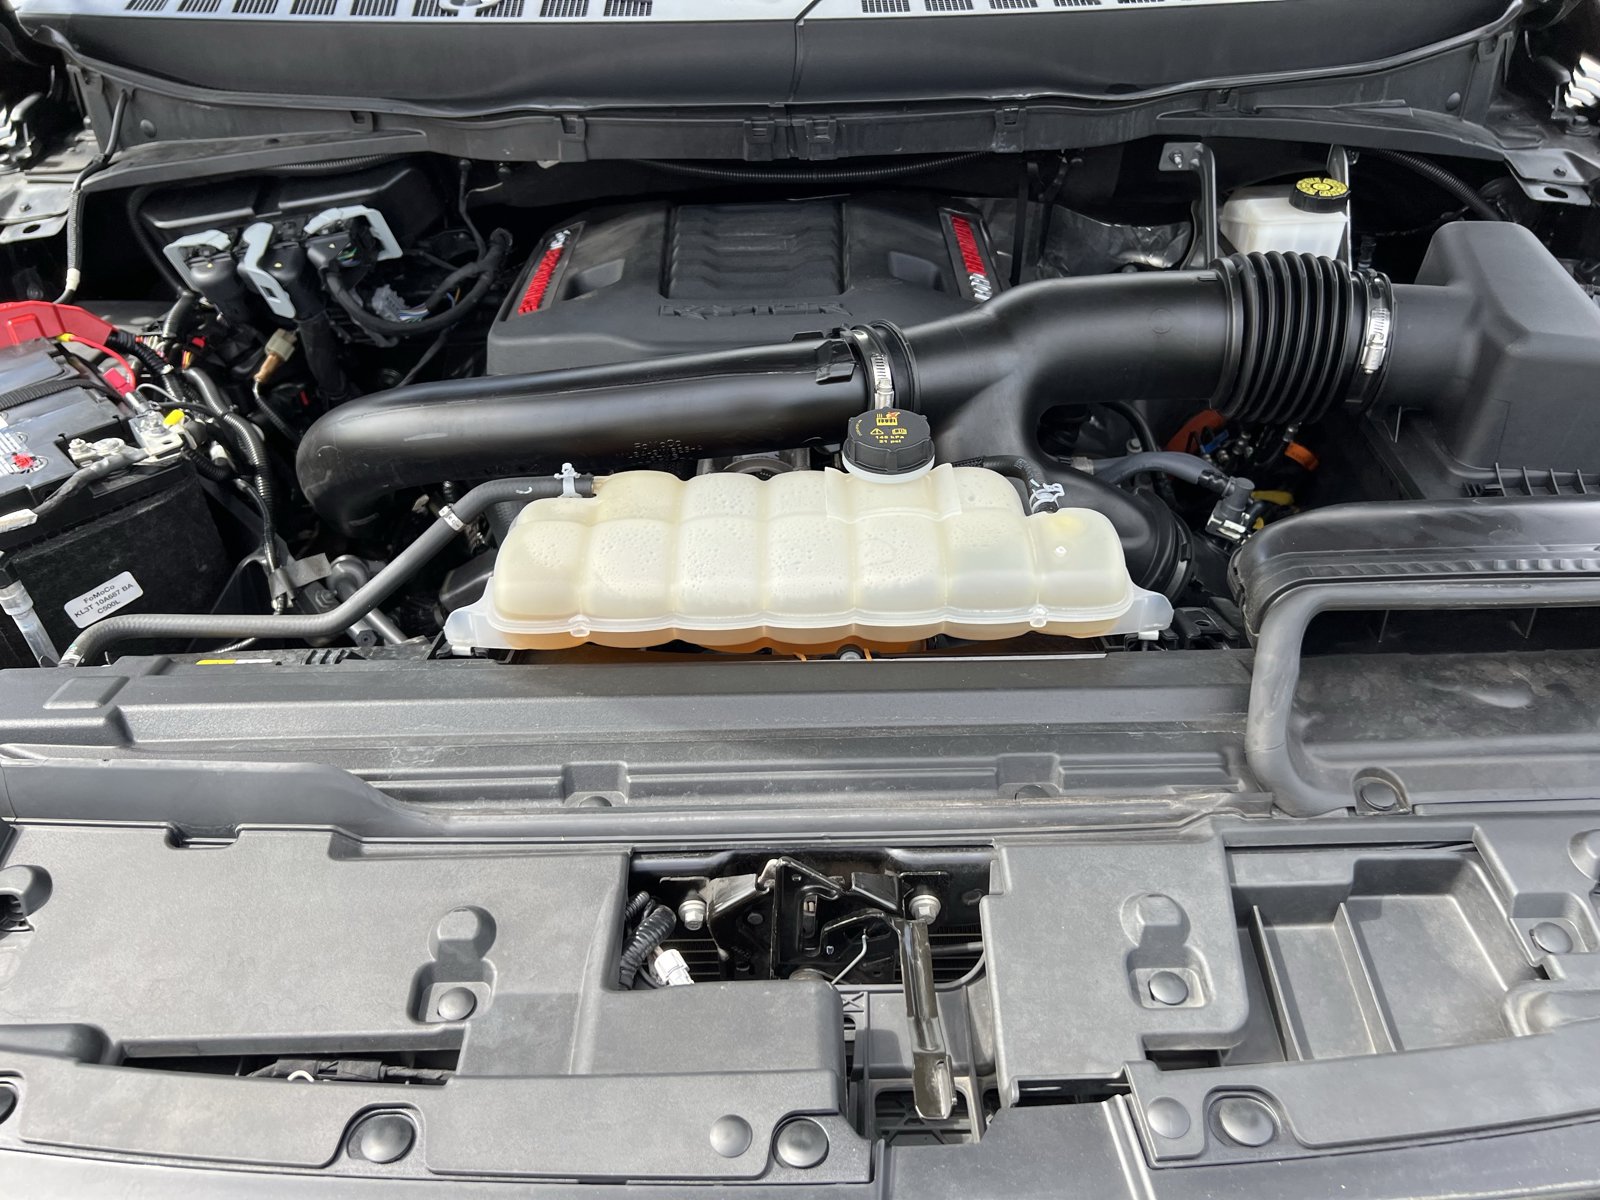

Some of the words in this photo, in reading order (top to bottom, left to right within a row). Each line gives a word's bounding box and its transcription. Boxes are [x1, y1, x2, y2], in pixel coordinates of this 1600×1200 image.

[74, 604, 94, 618] KL3T
[121, 583, 134, 592] BA
[83, 585, 115, 604] FoMoCo
[97, 600, 121, 614] C500L
